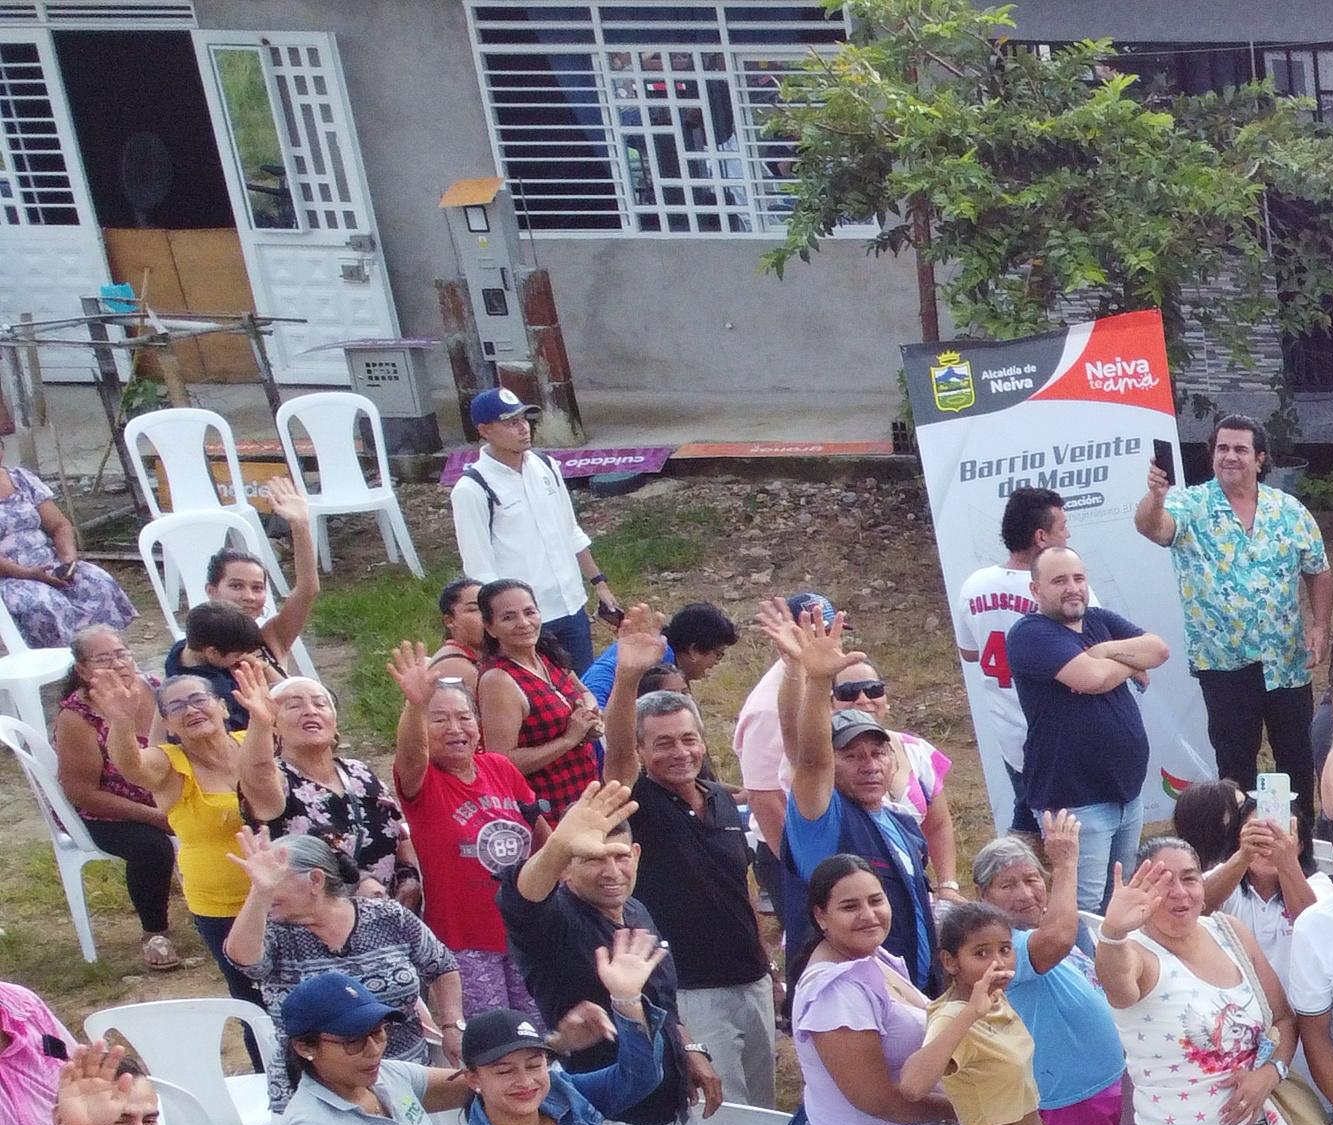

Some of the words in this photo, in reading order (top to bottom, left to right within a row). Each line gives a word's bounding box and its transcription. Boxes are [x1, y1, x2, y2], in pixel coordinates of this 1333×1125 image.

[981, 364, 1022, 381] Alcaldía
[1023, 363, 1037, 374] de
[1085, 357, 1150, 381] Neiva
[990, 376, 1034, 394] Neiva
[1088, 380, 1102, 390] te
[1102, 373, 1160, 394] ama
[566, 454, 646, 469] cuidado
[959, 450, 1046, 483] Barrio
[1052, 436, 1142, 465] Veinte
[1036, 465, 1109, 490] Mayo
[493, 838, 518, 857] 89
